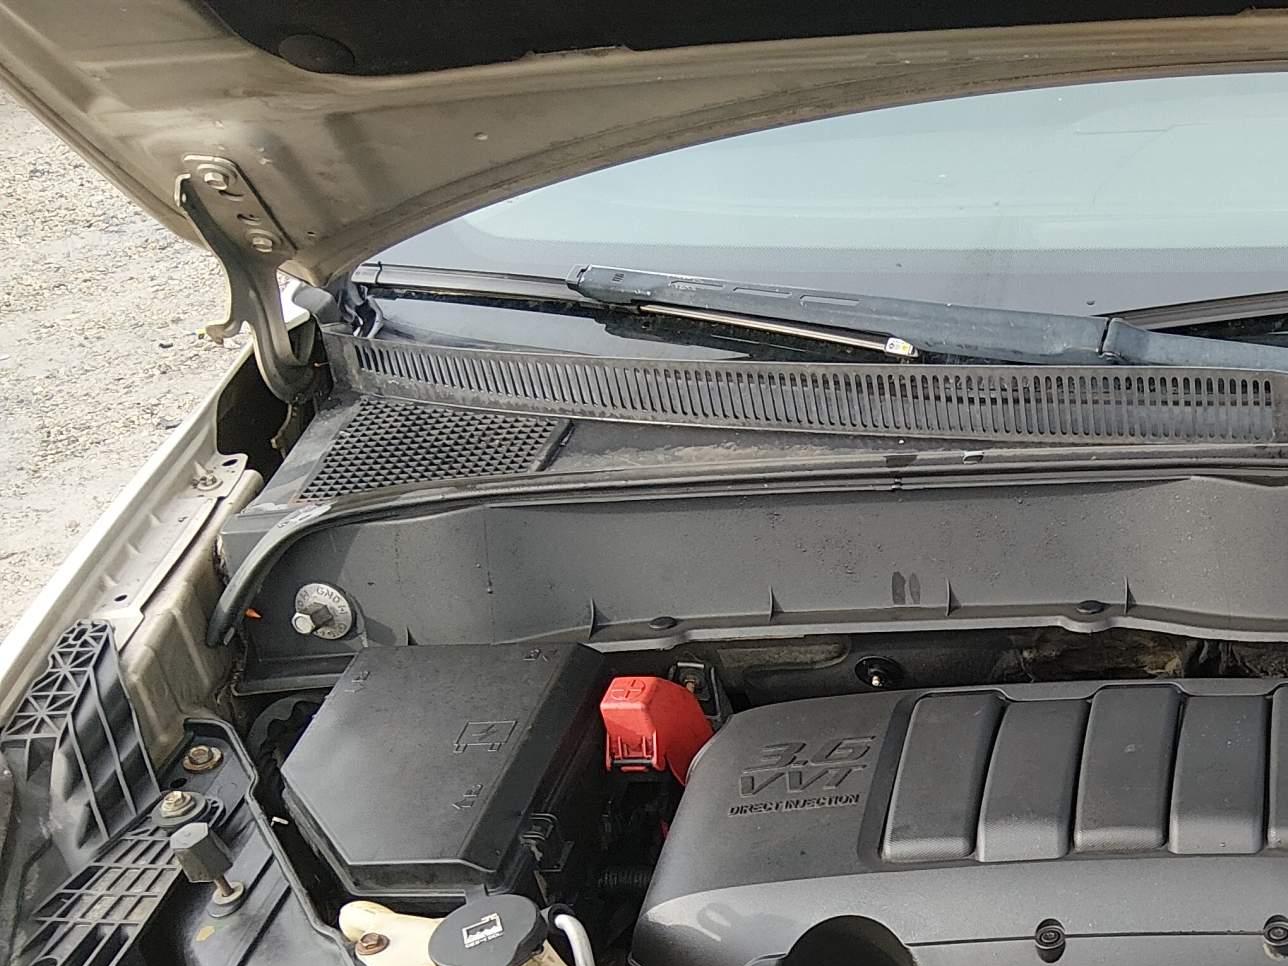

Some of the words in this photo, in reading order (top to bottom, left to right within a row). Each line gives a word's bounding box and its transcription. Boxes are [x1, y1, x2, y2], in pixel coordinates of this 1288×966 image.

[743, 736, 877, 774] 3.6
[739, 765, 868, 798] VVT
[728, 802, 784, 817] DIRECT
[783, 794, 860, 811] INJECTION
